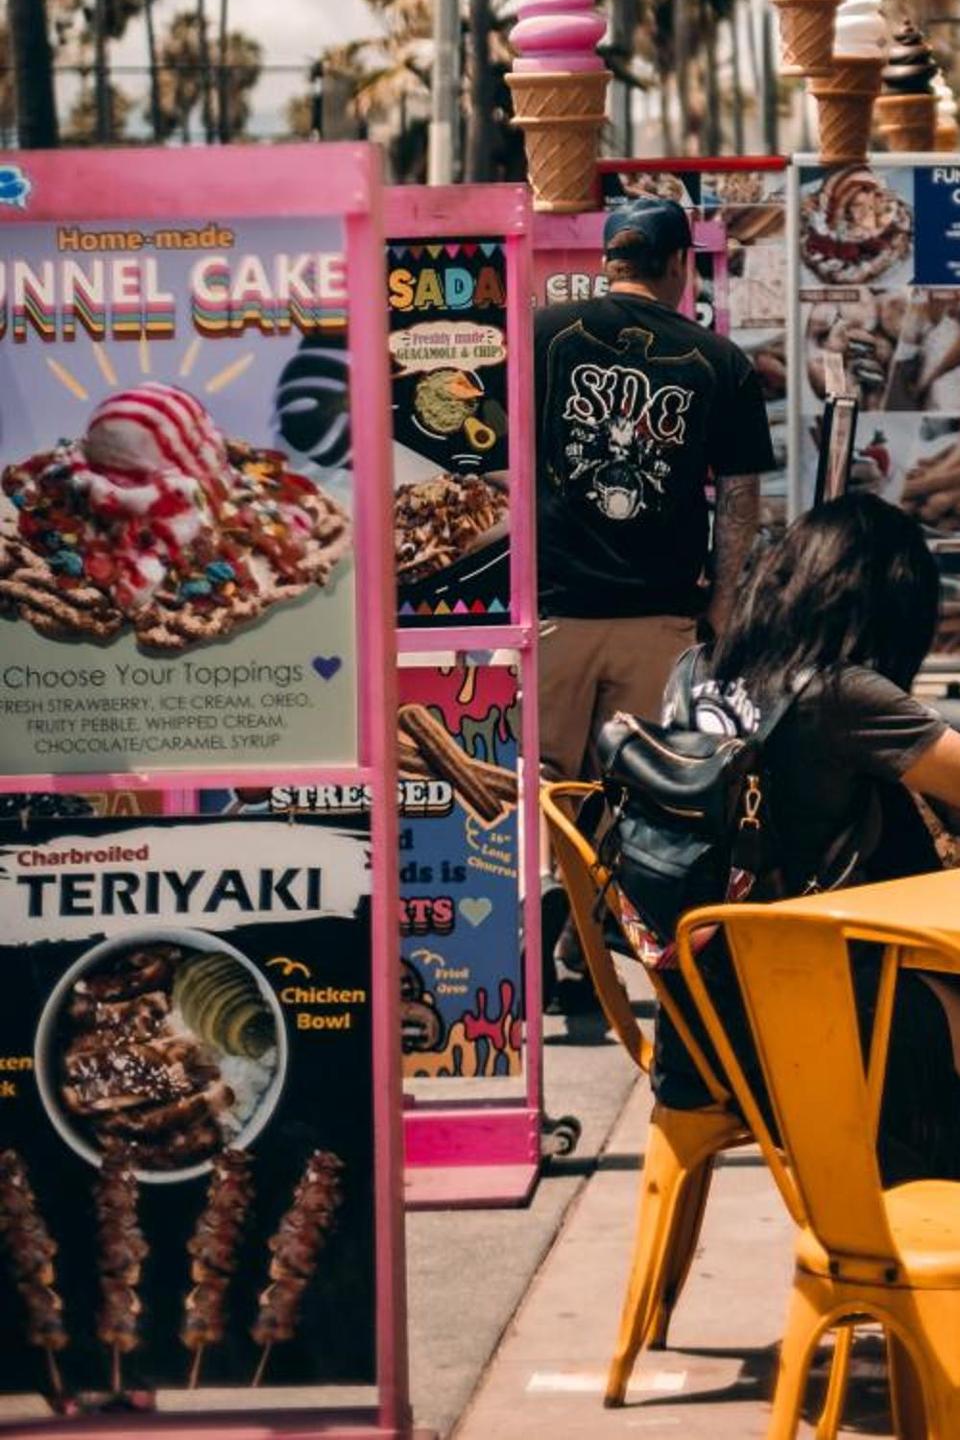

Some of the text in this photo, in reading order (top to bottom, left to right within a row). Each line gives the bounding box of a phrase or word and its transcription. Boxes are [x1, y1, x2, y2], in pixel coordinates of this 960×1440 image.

[57, 224, 235, 251] Home-made
[0, 254, 348, 337] NNEL CAKE
[3, 660, 304, 689] Choose Your Toppings
[160, 696, 187, 710] ICE
[27, 718, 76, 734] FRUITY
[145, 714, 218, 730] WHIPPED
[230, 733, 281, 749] SYRUP
[17, 844, 150, 867] Charbroiled
[442, 861, 467, 883] is
[16, 867, 322, 918] TERIYAKI
[280, 986, 367, 1004] Chicken
[296, 1011, 351, 1031] Bowl
